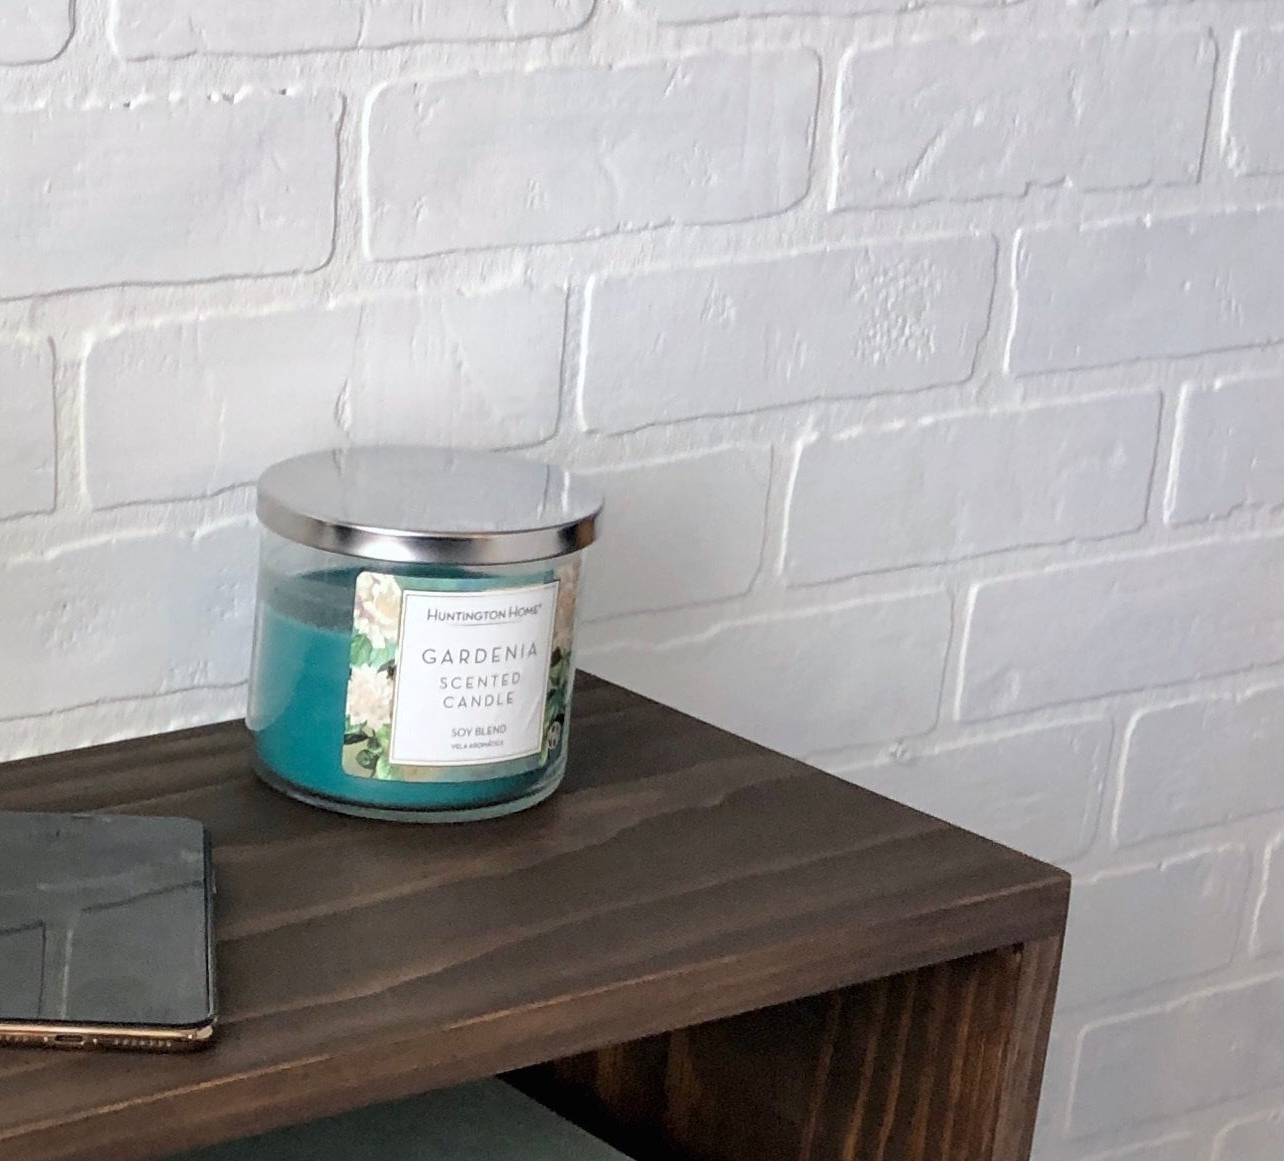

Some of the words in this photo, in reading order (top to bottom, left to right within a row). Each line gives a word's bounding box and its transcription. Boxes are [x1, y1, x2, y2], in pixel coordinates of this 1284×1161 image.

[421, 642, 537, 665] GARDENIA
[439, 672, 521, 690] SCENTED
[443, 691, 515, 709] CANDLE
[451, 728, 472, 738] SOY
[475, 724, 507, 737] BLEND
